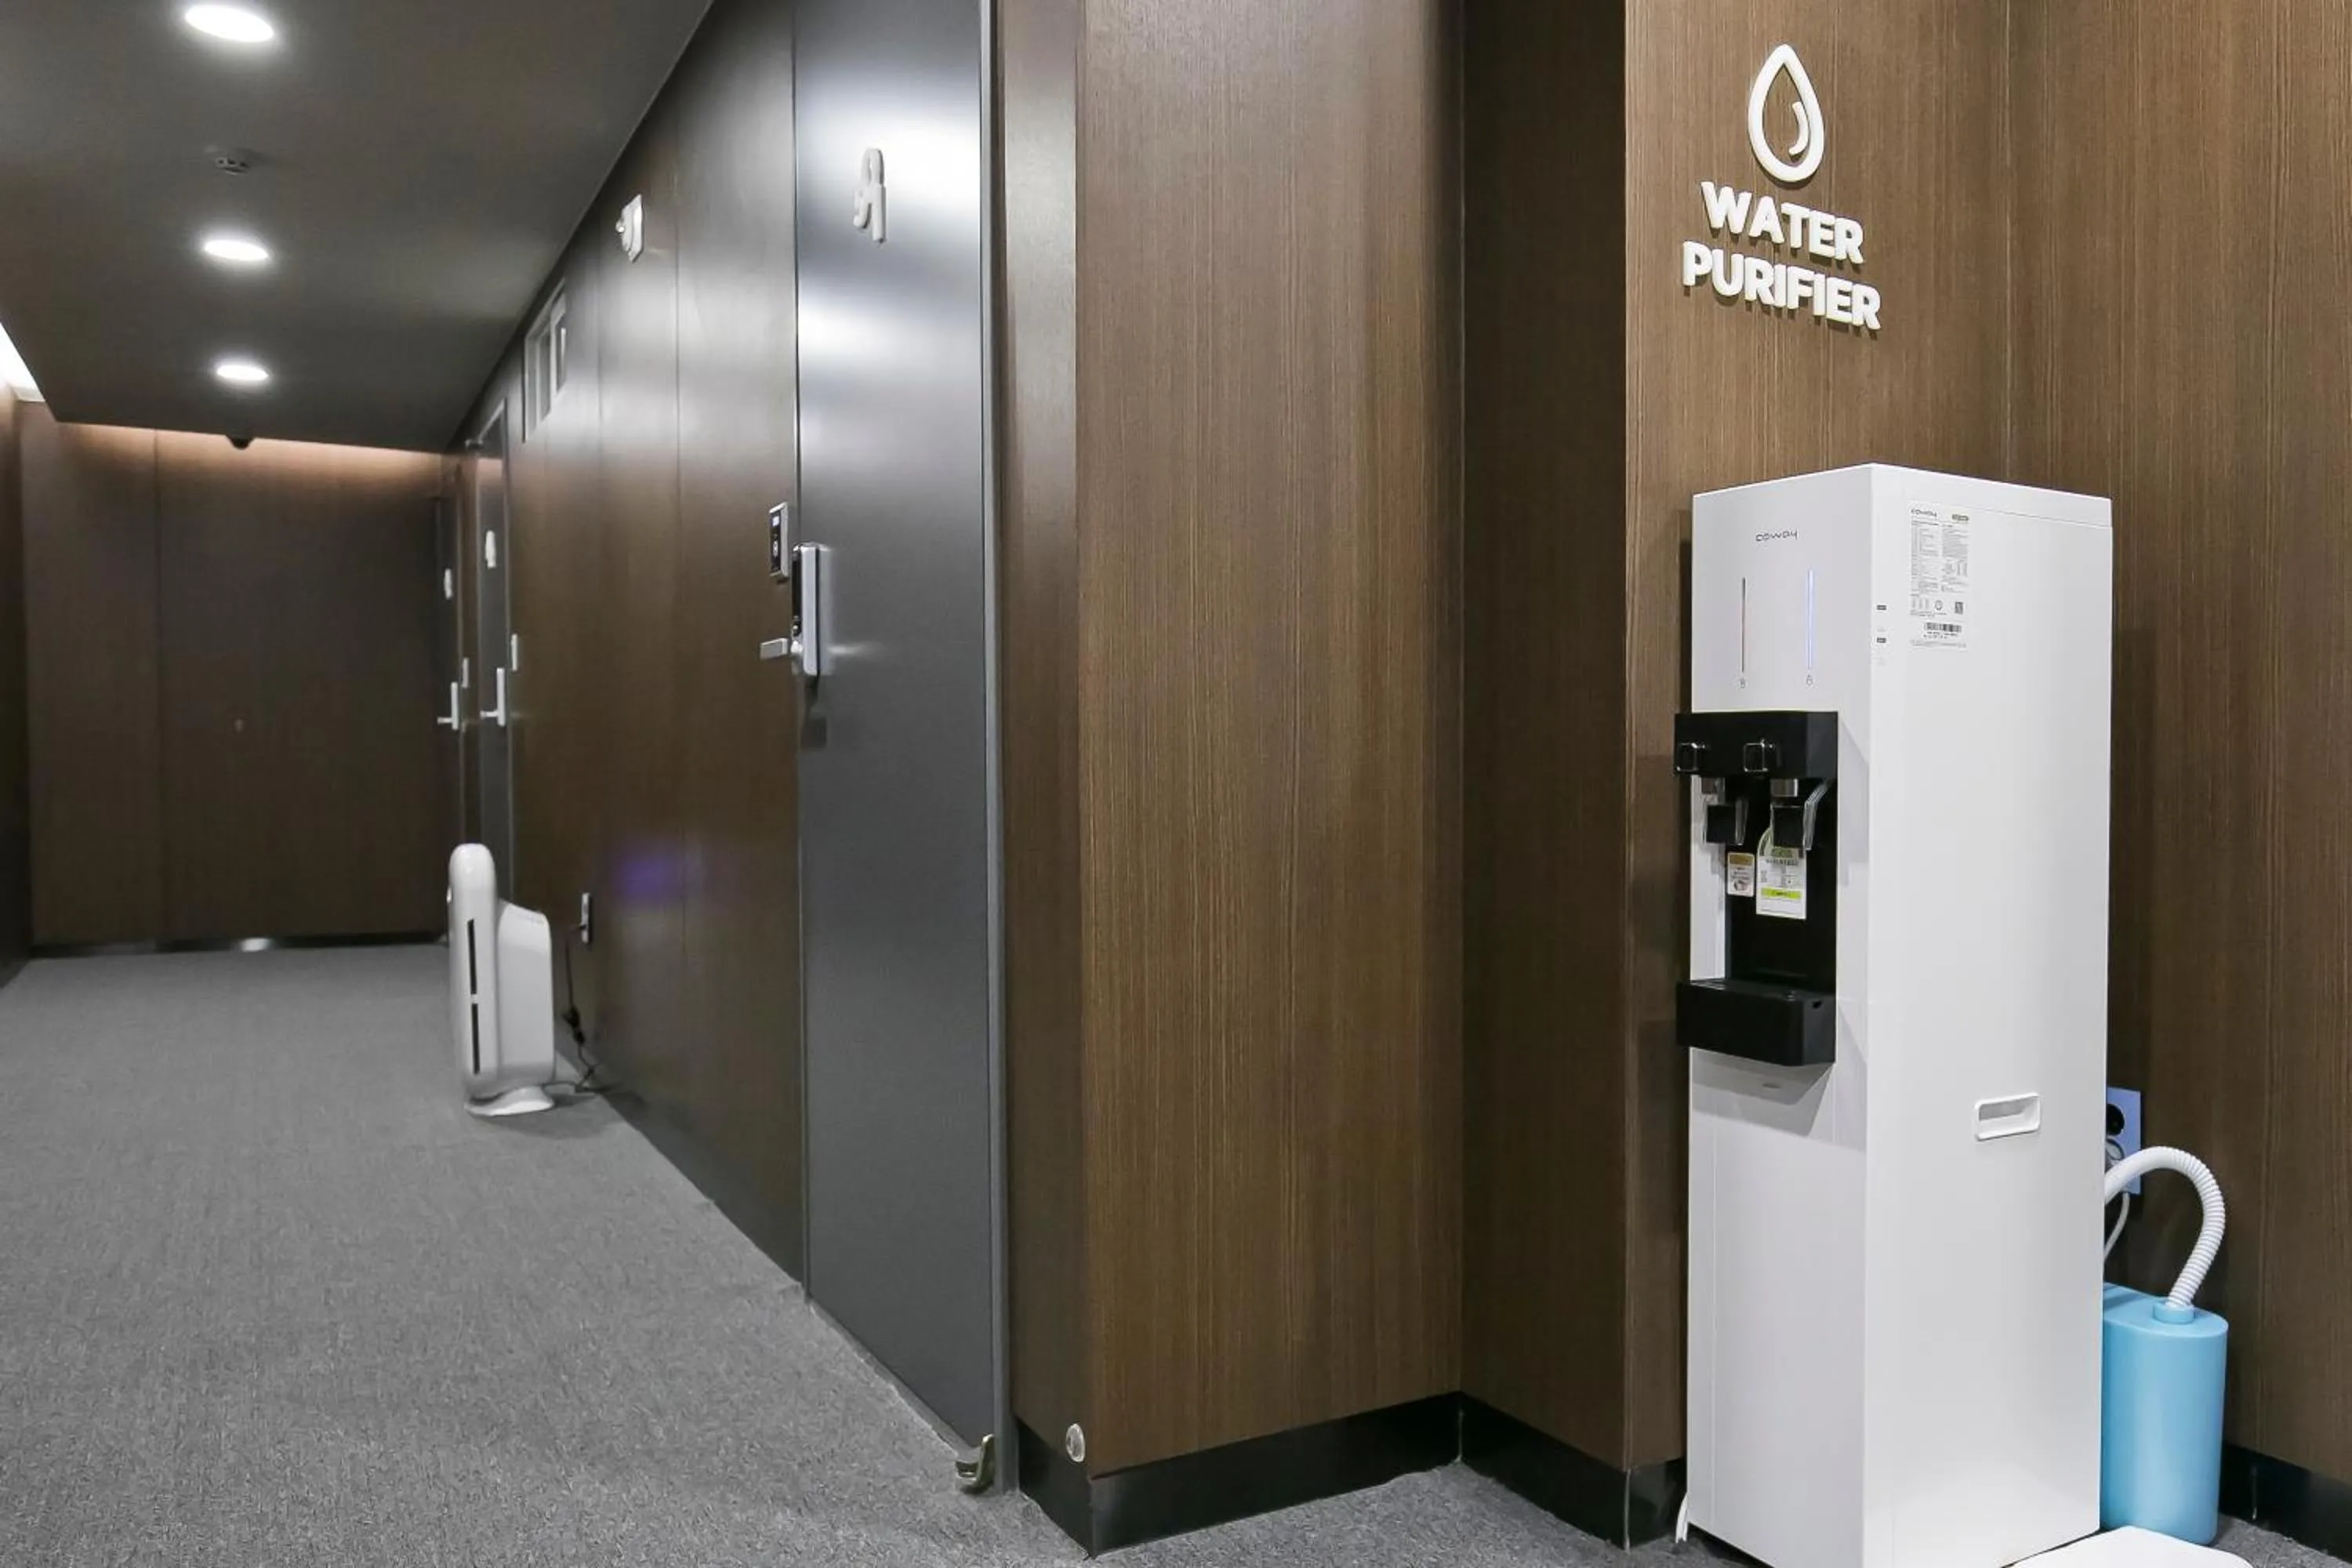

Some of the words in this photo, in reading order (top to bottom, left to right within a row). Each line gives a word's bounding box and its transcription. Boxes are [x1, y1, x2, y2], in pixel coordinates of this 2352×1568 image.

[1700, 181, 1864, 264] WATER
[1682, 241, 1882, 330] PURIFIER
[1755, 529, 1798, 542] coway
